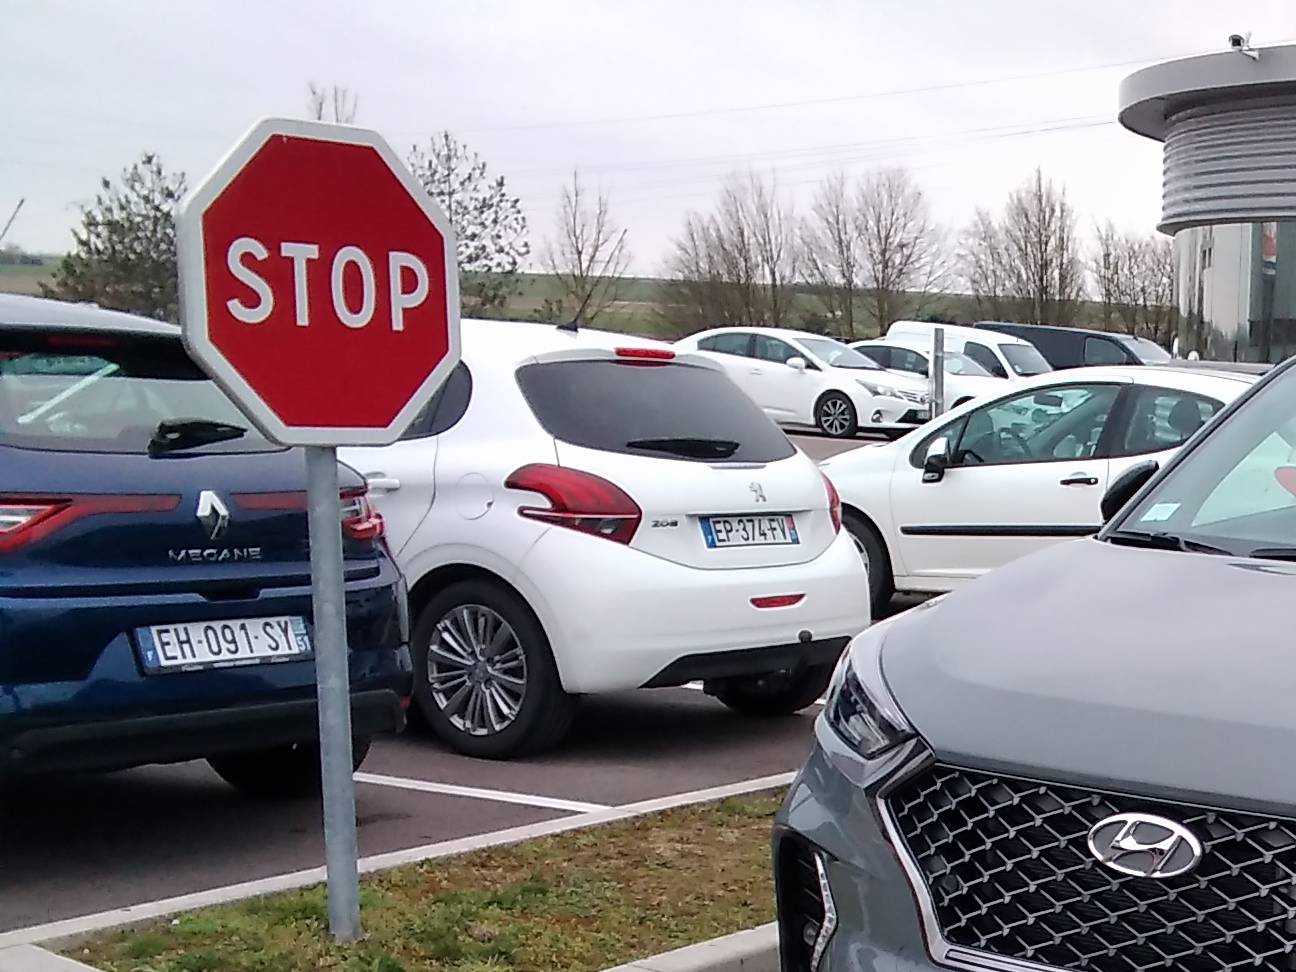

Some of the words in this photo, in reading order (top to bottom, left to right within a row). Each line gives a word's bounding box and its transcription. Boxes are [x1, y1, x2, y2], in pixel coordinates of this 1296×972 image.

[226, 236, 430, 332] STOP
[650, 519, 679, 528] 208
[712, 517, 787, 543] EP-374-FV
[168, 547, 263, 562] MEGANE
[156, 619, 293, 662] EH-091-SY
[296, 634, 311, 652] 51
